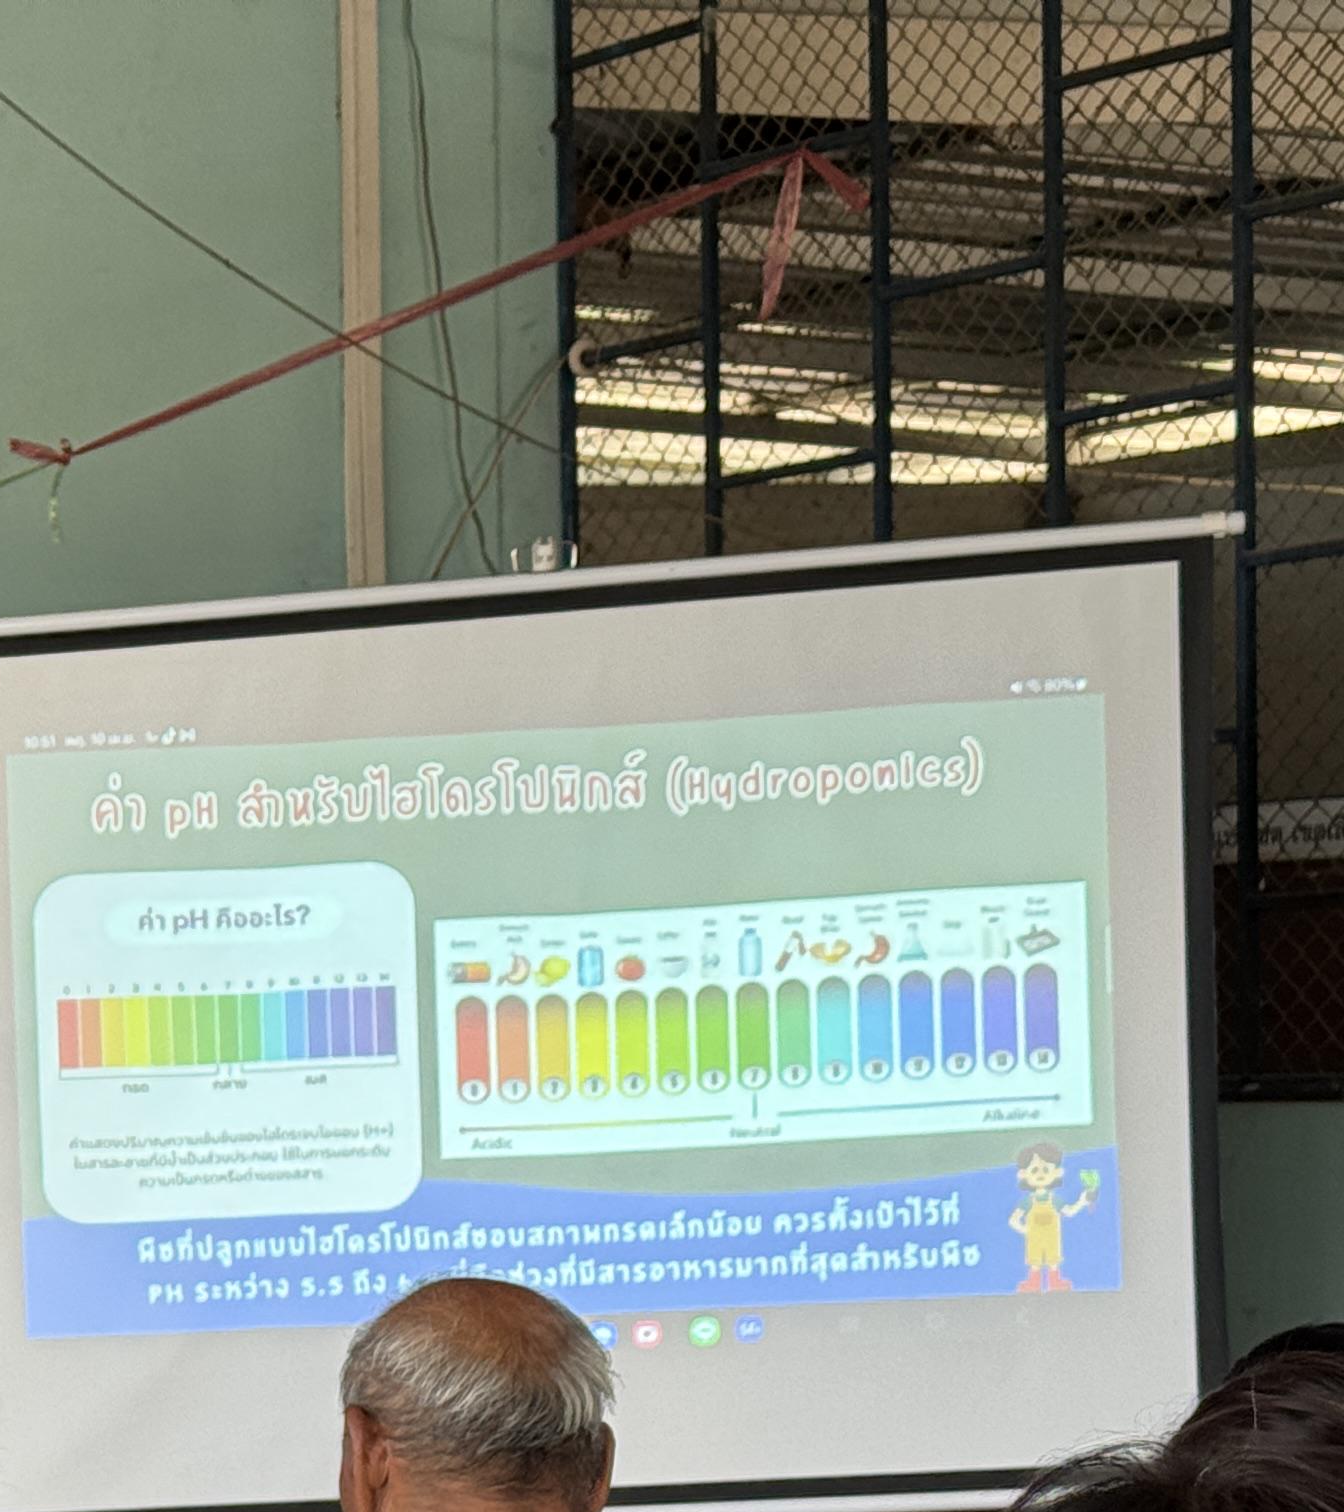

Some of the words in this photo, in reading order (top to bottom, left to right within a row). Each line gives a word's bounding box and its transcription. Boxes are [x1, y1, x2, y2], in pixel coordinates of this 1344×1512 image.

[91, 771, 146, 834] ค่า
[165, 790, 218, 838] pH
[238, 749, 649, 829] สำหรับไฮโดรโปนิกส์
[665, 736, 985, 816] (Hydroponics)
[138, 906, 166, 931] ค่า
[173, 909, 208, 935] pH
[215, 903, 311, 930] คืออะไร?
[471, 1136, 512, 1150] Acidic
[194, 1271, 289, 1301] ระหว่าง
[300, 1275, 344, 1298] 5.5
